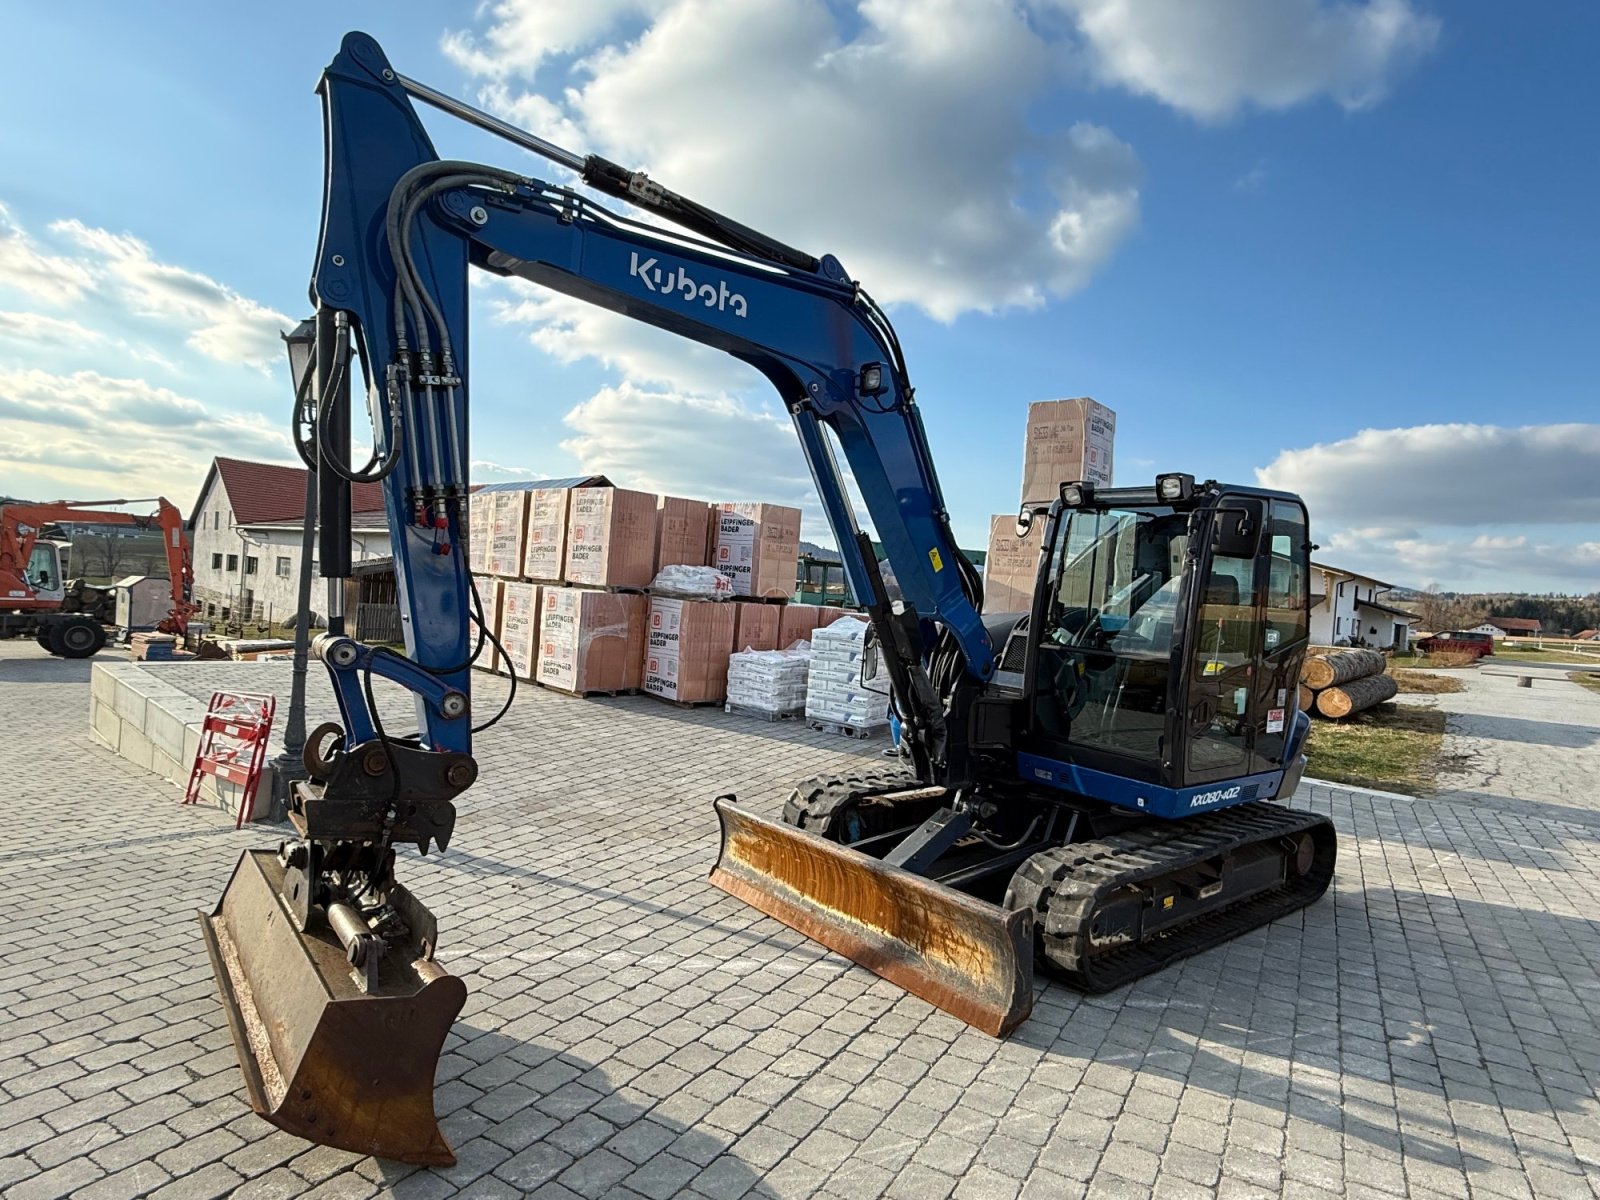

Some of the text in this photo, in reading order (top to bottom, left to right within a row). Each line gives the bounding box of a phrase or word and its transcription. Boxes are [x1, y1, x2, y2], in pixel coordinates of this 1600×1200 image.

[630, 251, 747, 318] Kubota
[721, 518, 754, 526] LEIPFINGER
[720, 525, 740, 533] BADER
[717, 564, 751, 574] LEIPFINGER
[720, 571, 736, 579] ADER
[650, 632, 678, 641] LEIPFINGER
[650, 639, 666, 647] BADER
[543, 667, 560, 675] BADER
[647, 675, 676, 690] LEIPFINGER
[646, 683, 663, 692] BADER
